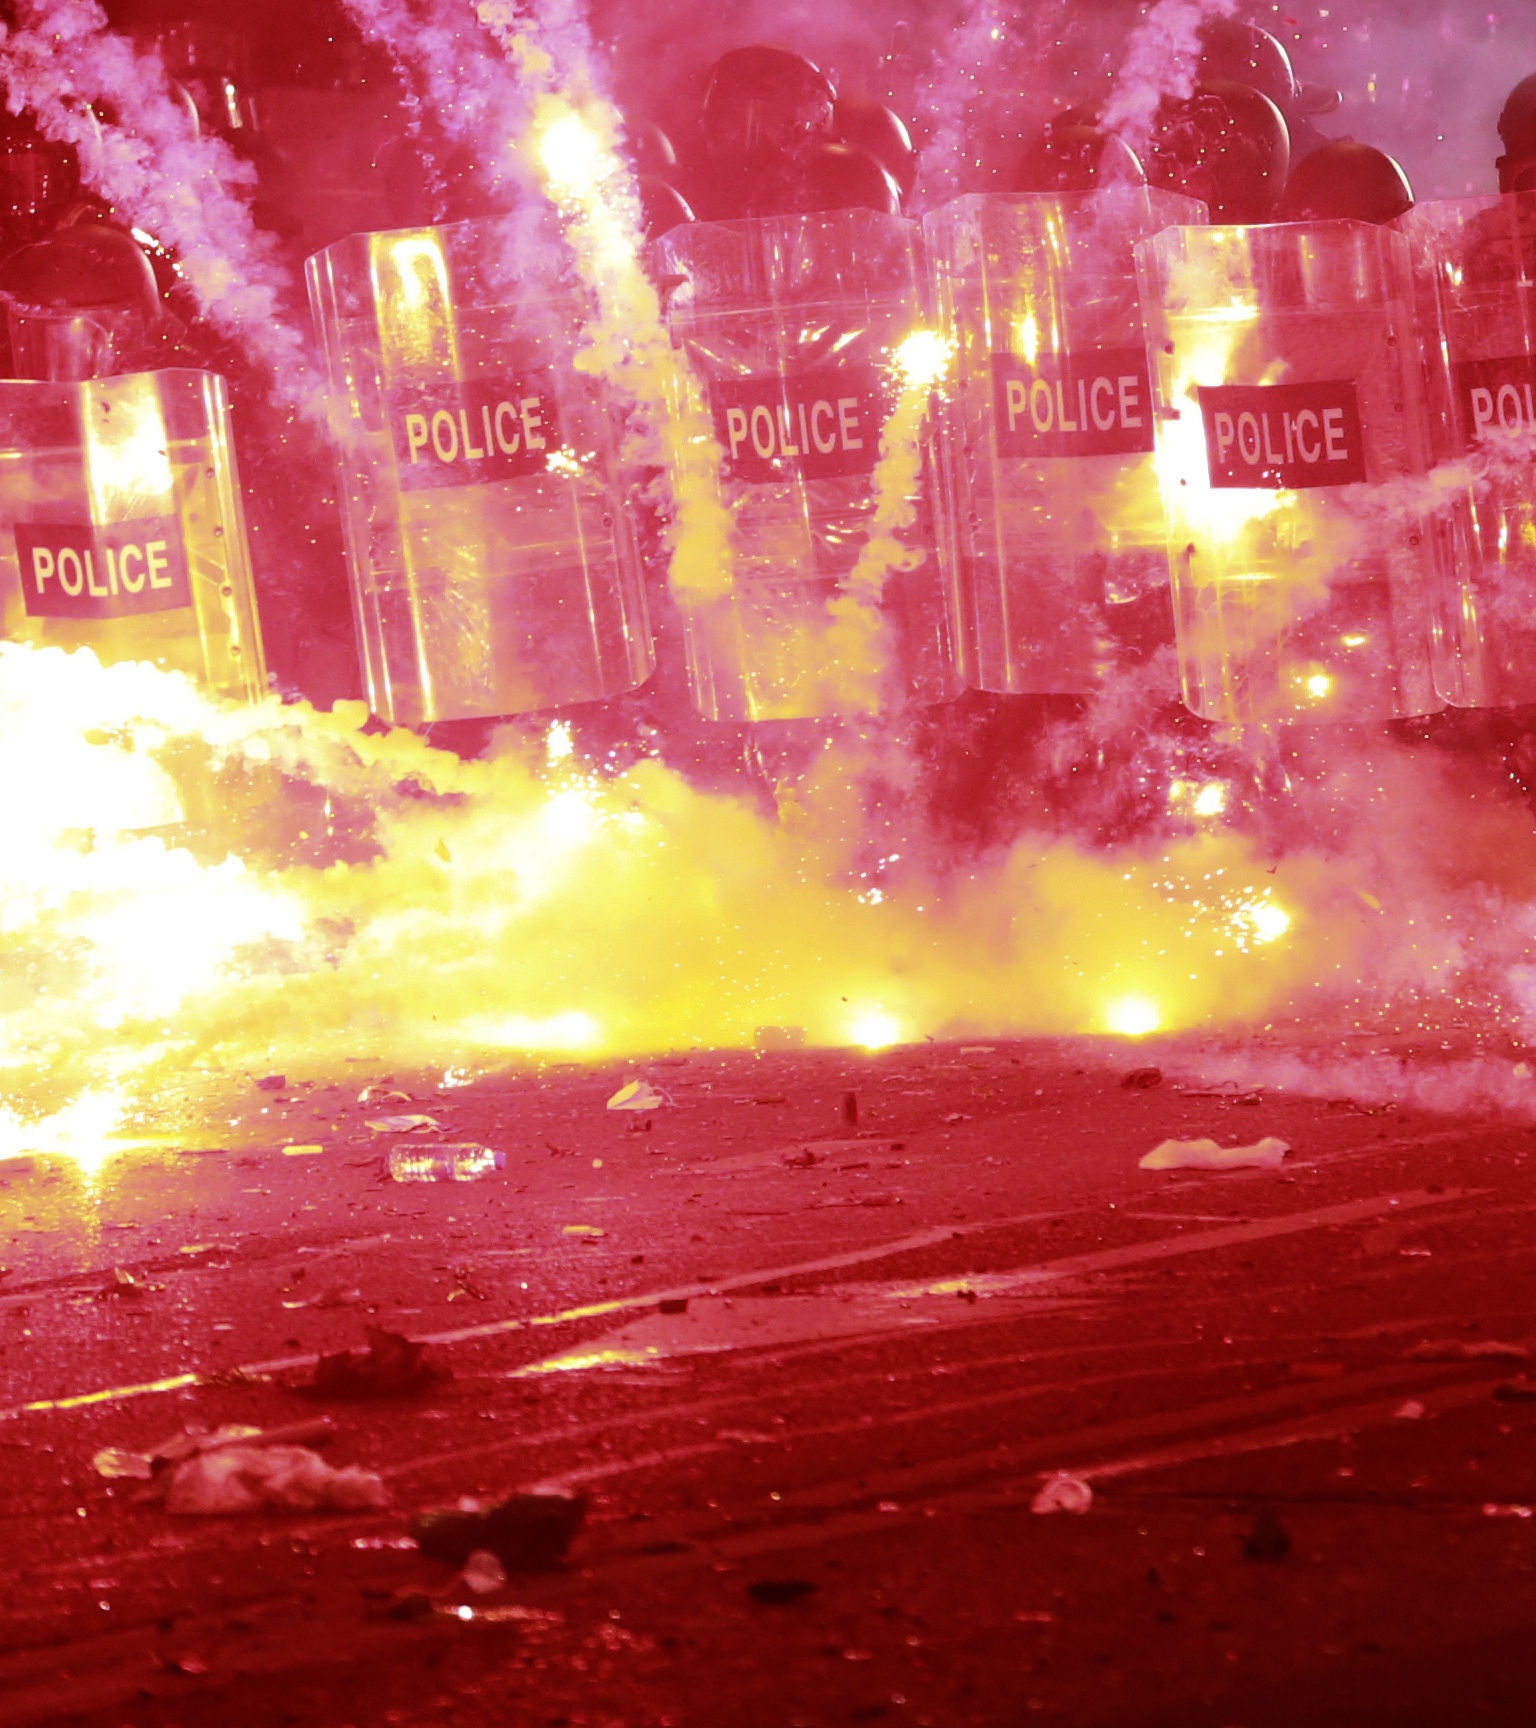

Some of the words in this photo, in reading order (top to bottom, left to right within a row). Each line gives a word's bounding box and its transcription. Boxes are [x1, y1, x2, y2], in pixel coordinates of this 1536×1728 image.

[405, 397, 546, 465] POLICE
[726, 396, 864, 461] POLICE
[1005, 375, 1143, 434] POLICE
[1214, 408, 1349, 466] POLICE
[32, 540, 173, 597] POLICE
